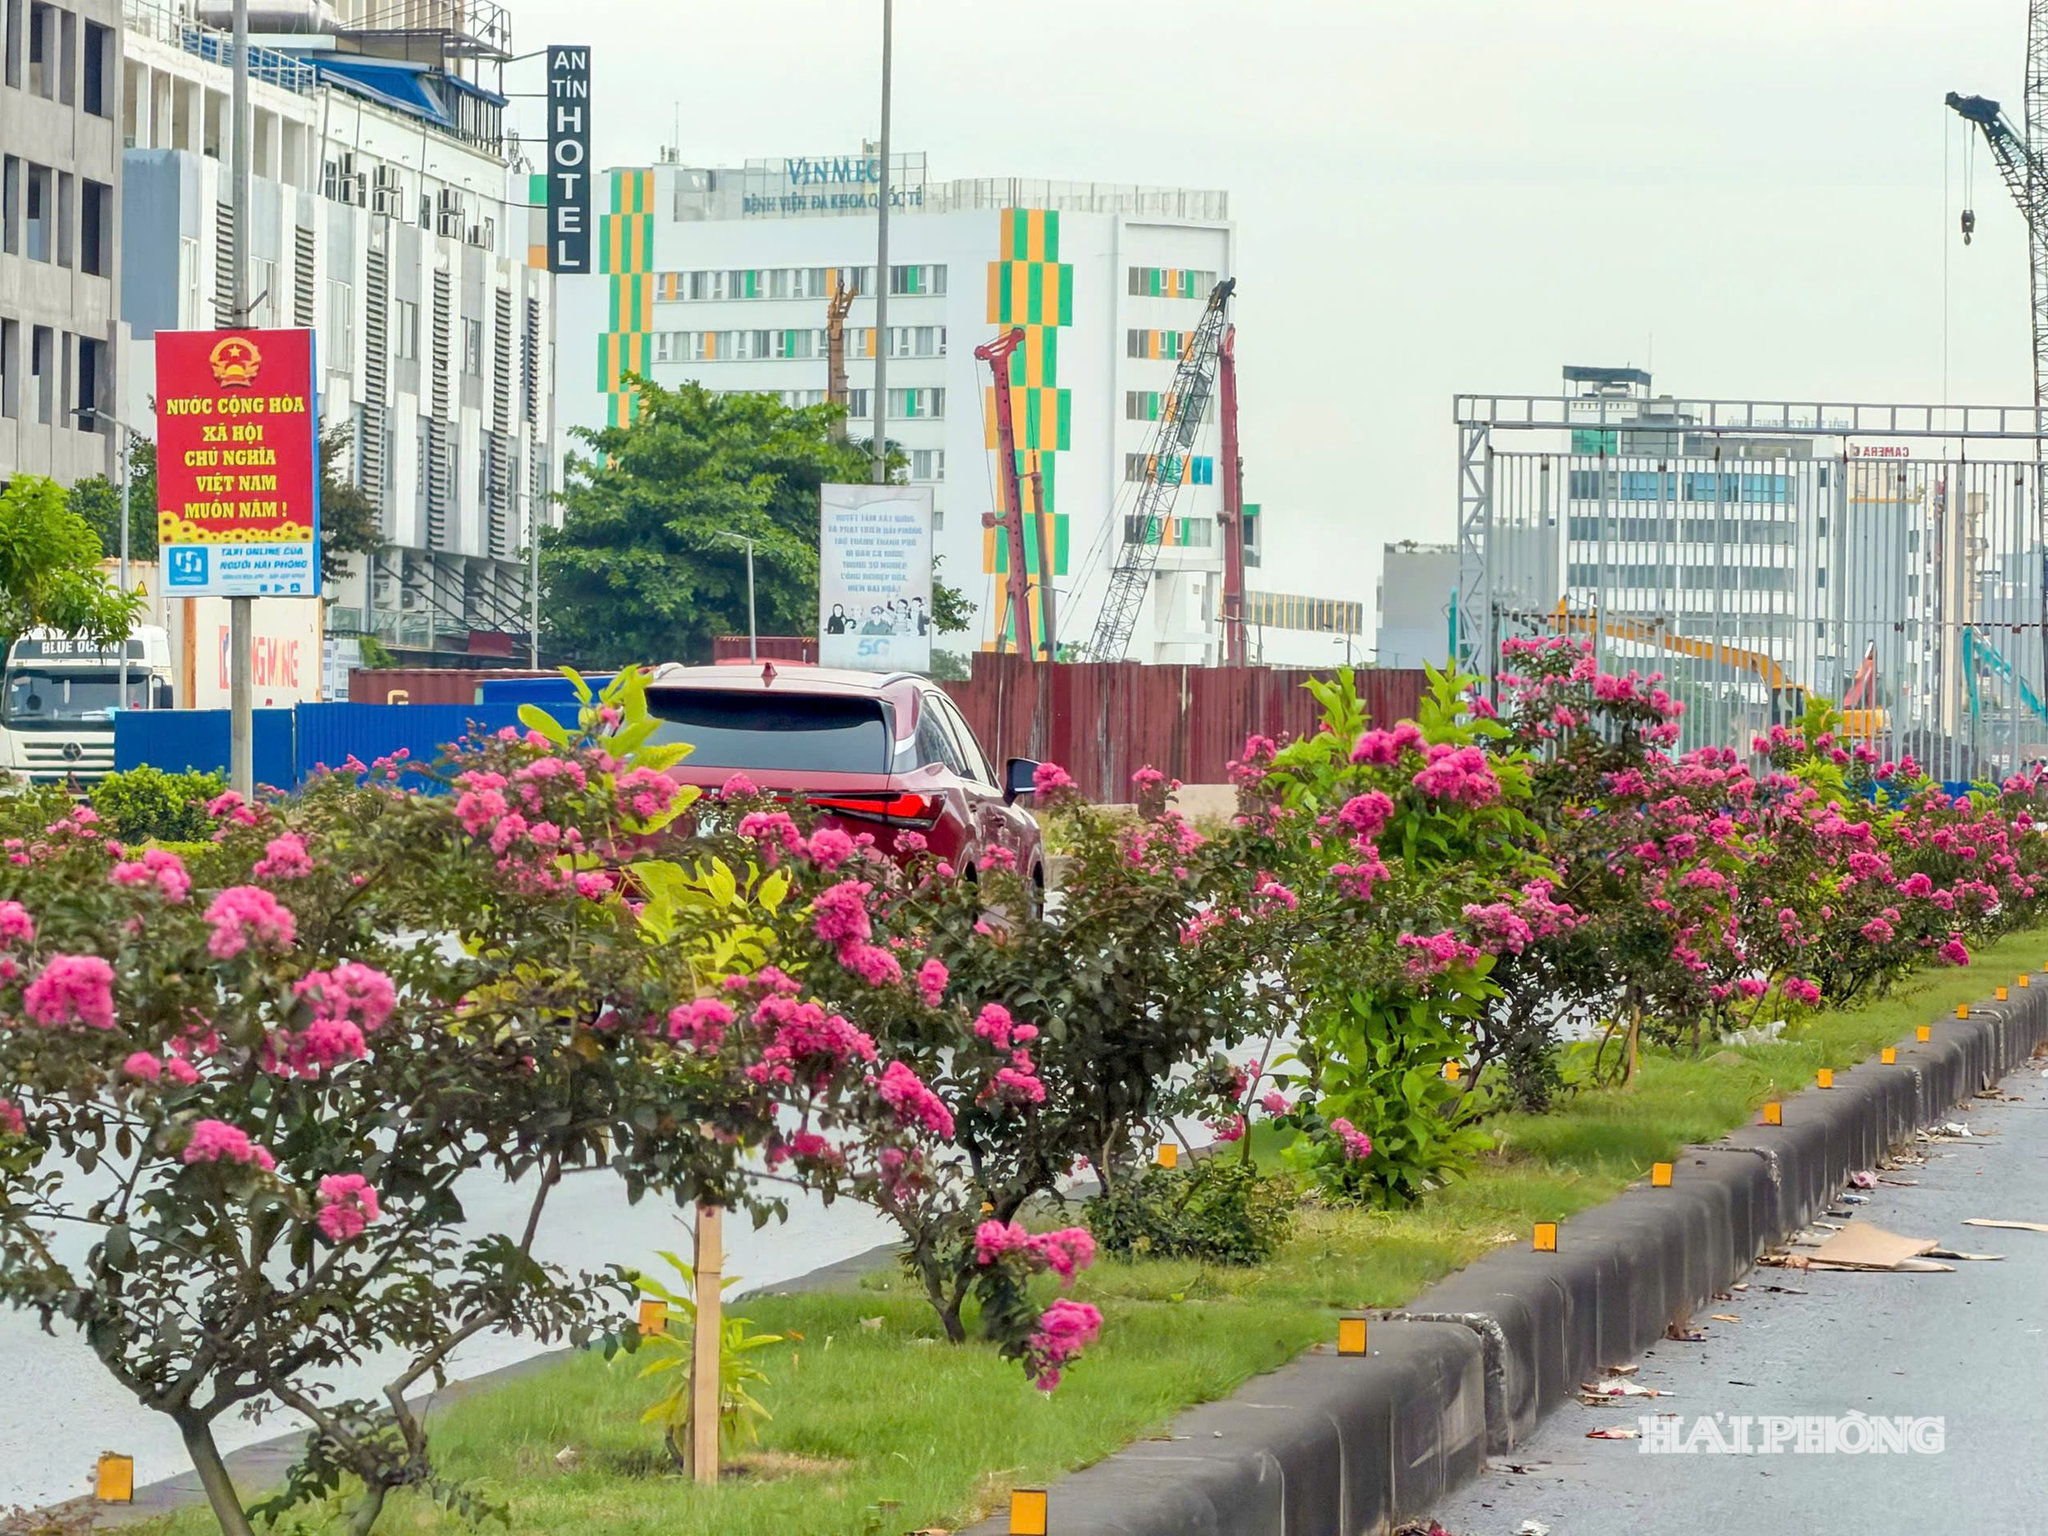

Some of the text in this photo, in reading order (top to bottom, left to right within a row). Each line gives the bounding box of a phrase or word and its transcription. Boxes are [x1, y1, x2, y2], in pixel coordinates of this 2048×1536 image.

[553, 51, 586, 70] AN
[551, 75, 587, 98] TÍN
[554, 106, 584, 267] HOTEL
[744, 185, 922, 215] BỆNH VIỆN ĐA KHOA QỐC TẾ
[166, 393, 305, 418] NƯỚC CỘNG HÒA
[202, 421, 263, 445] XÃ HỘI
[184, 446, 276, 466] CHỦ NGHĨA
[196, 471, 277, 495] VIỆT NAM
[184, 499, 235, 519] MUÔN
[239, 499, 277, 518] NĂM
[221, 547, 243, 556] TAXI
[246, 547, 281, 556] ONLINE
[41, 641, 73, 654] BLUE
